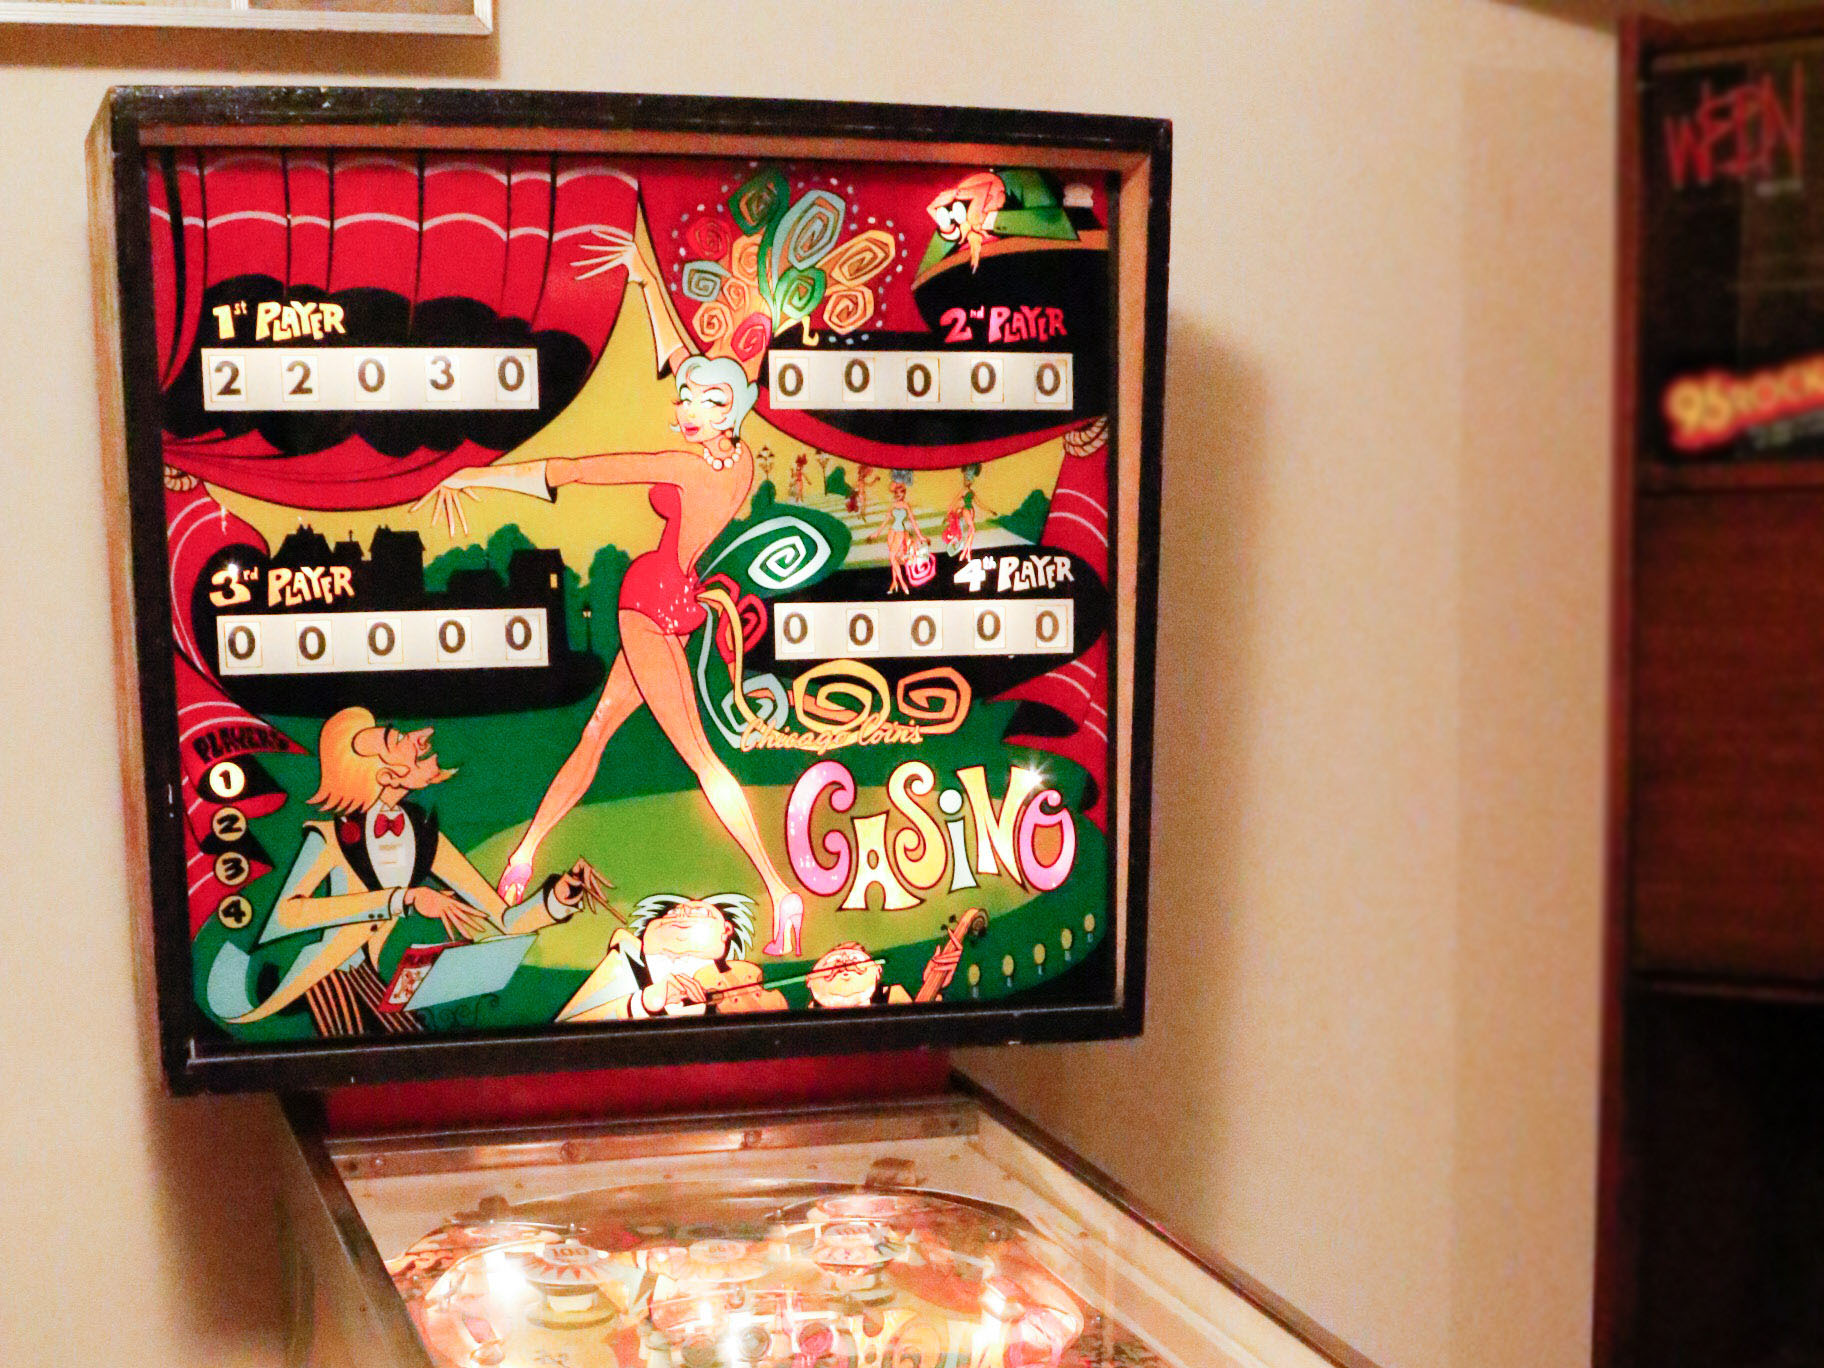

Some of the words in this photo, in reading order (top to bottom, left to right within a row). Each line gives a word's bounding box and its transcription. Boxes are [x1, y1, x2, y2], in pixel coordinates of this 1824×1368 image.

[212, 300, 248, 340] 1st
[255, 300, 346, 341] PLAYER
[940, 305, 985, 343] 2nd
[988, 304, 1068, 344] PLAYER
[267, 565, 355, 608] PLAYER
[997, 554, 1076, 593] PLAYER
